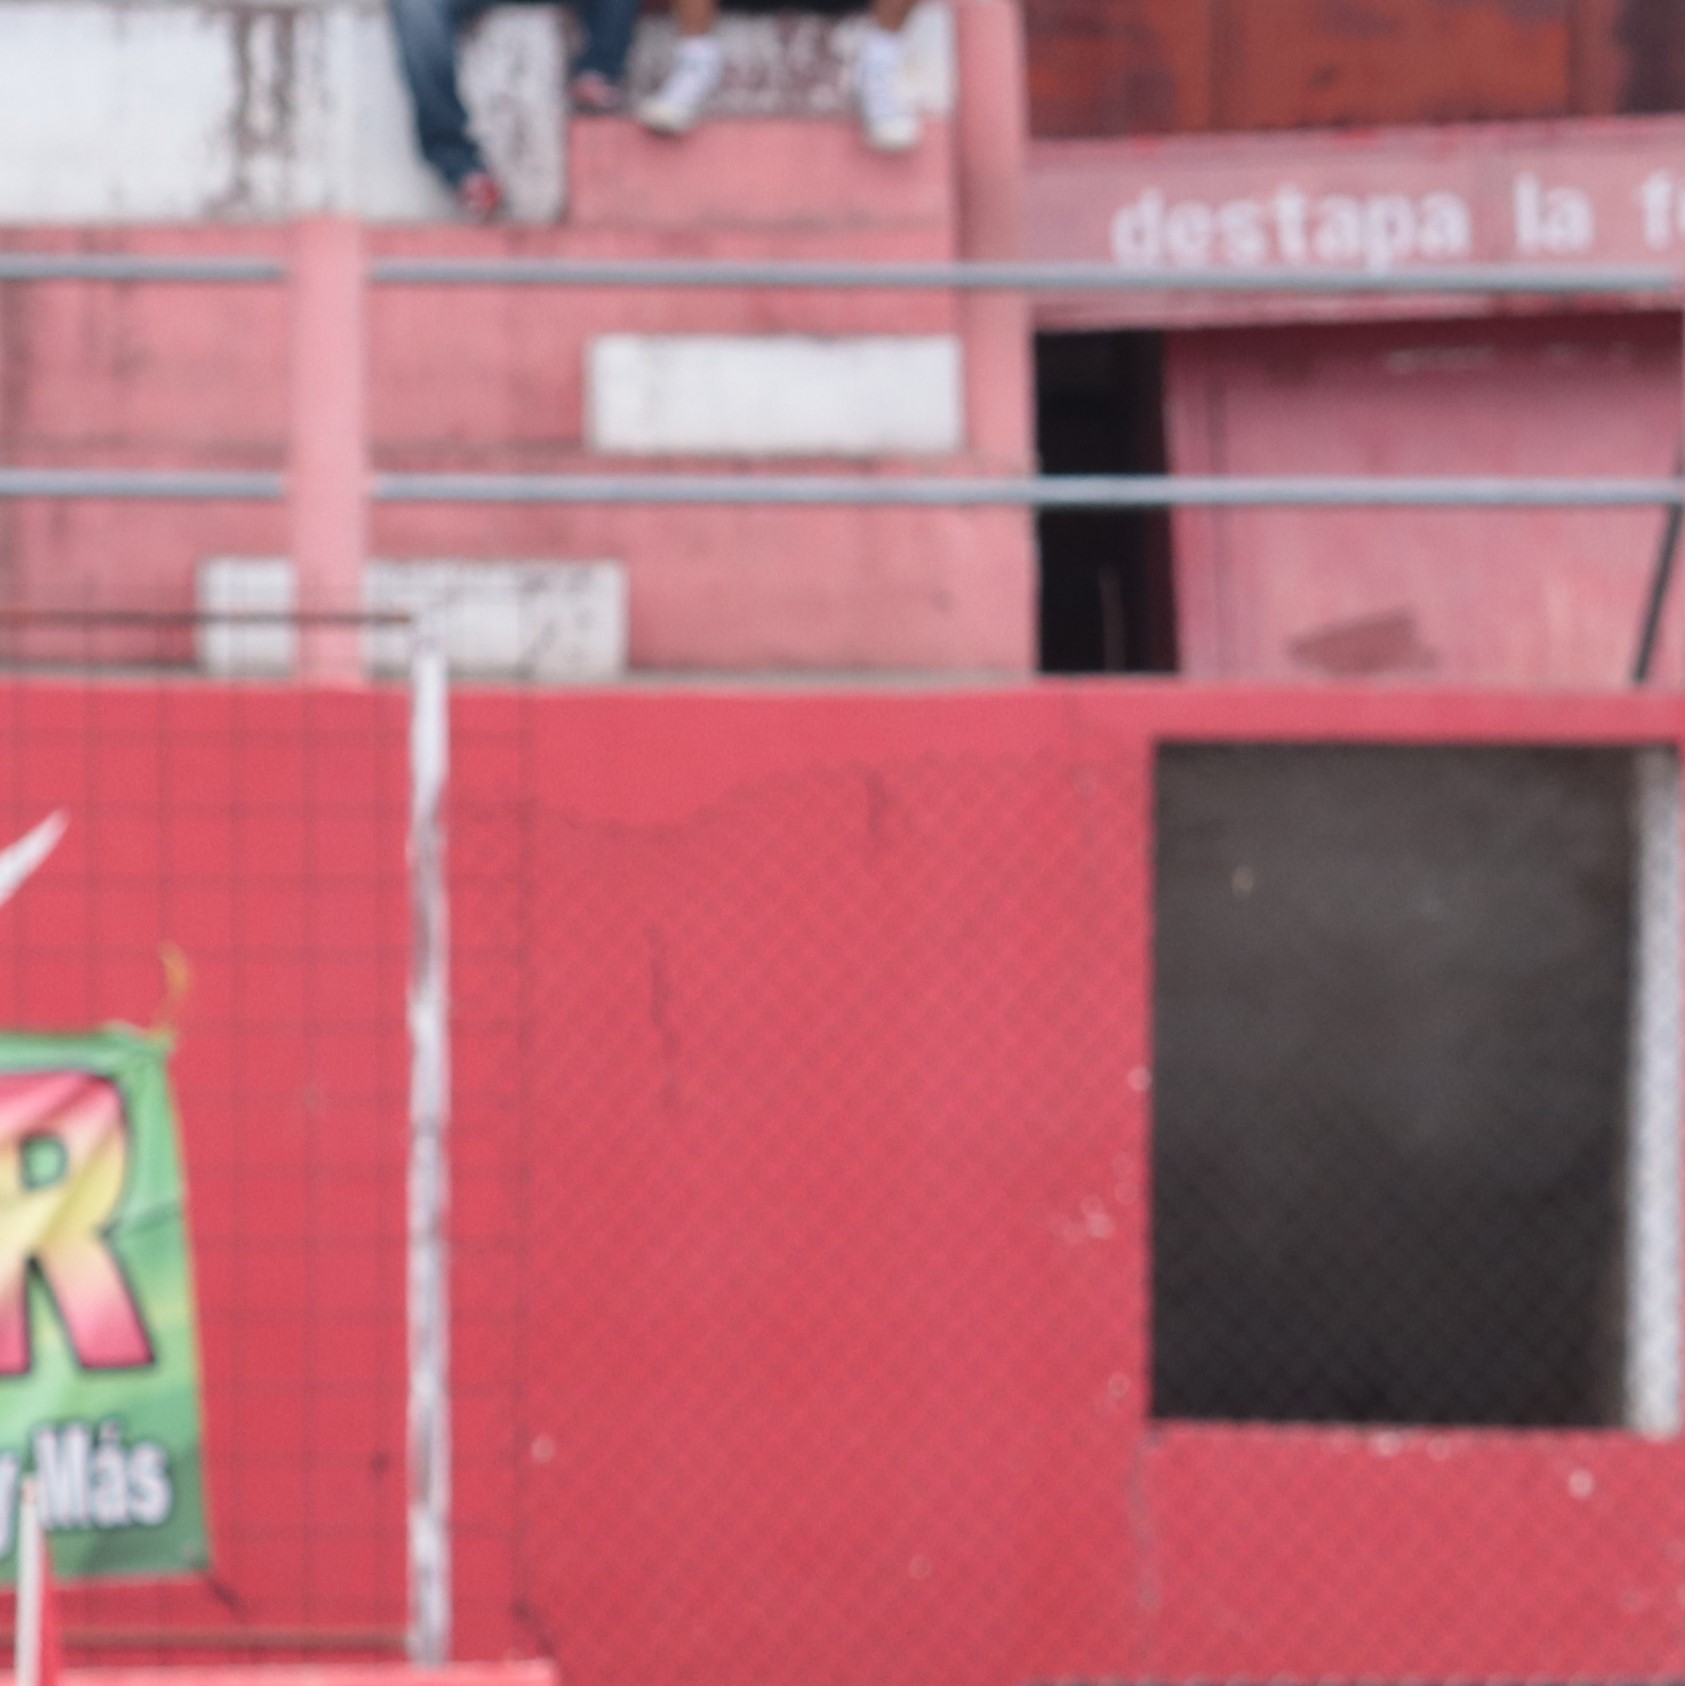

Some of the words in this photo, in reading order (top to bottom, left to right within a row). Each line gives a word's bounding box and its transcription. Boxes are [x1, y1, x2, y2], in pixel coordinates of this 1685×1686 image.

[1110, 184, 1474, 276] destapa
[1514, 174, 1597, 254] la
[35, 1421, 173, 1529] Más
